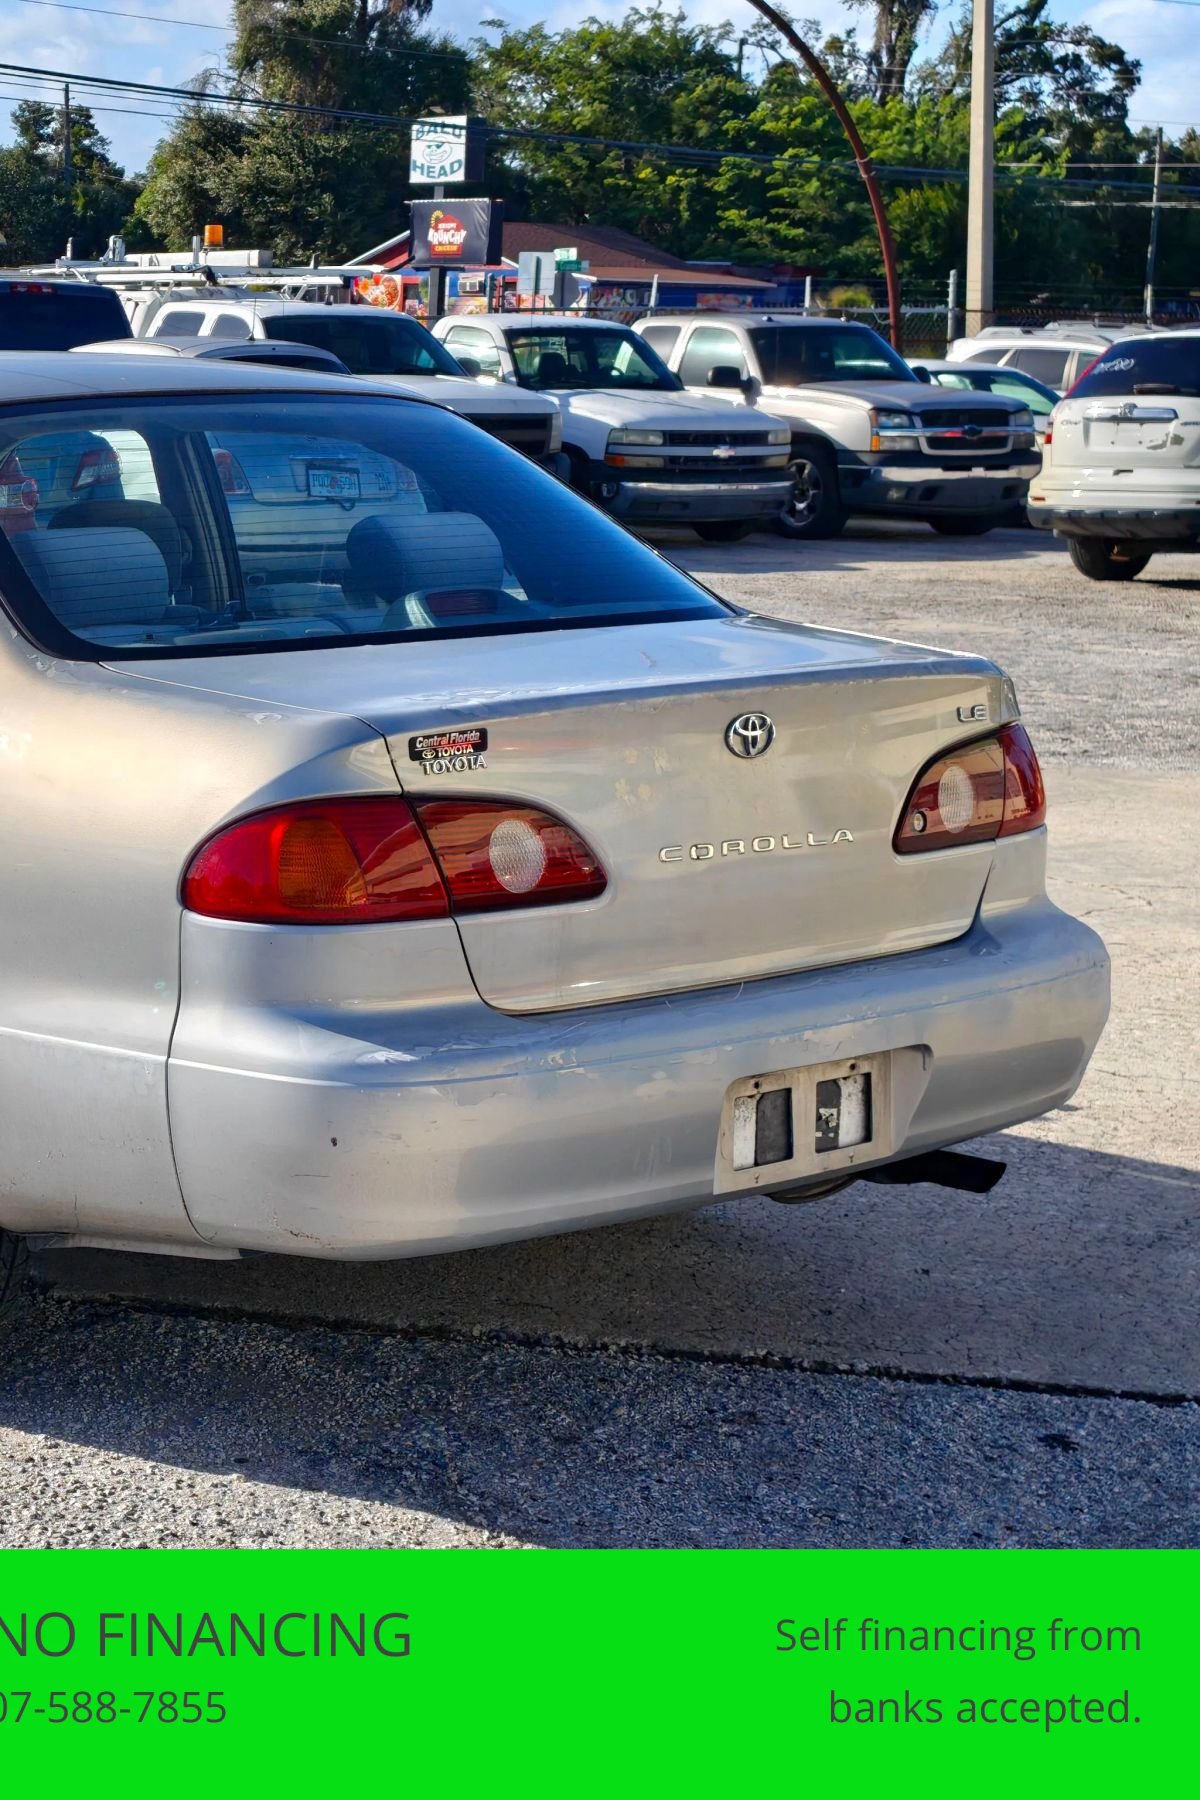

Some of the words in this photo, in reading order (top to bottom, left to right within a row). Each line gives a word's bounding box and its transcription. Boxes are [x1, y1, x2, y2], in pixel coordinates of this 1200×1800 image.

[412, 158, 463, 179] HEAD
[956, 704, 987, 722] LE
[416, 733, 448, 748] Central
[450, 730, 480, 743] Florida
[436, 743, 474, 757] TOYOTA
[422, 755, 487, 775] TOYOTA
[659, 829, 854, 862] COROLLA
